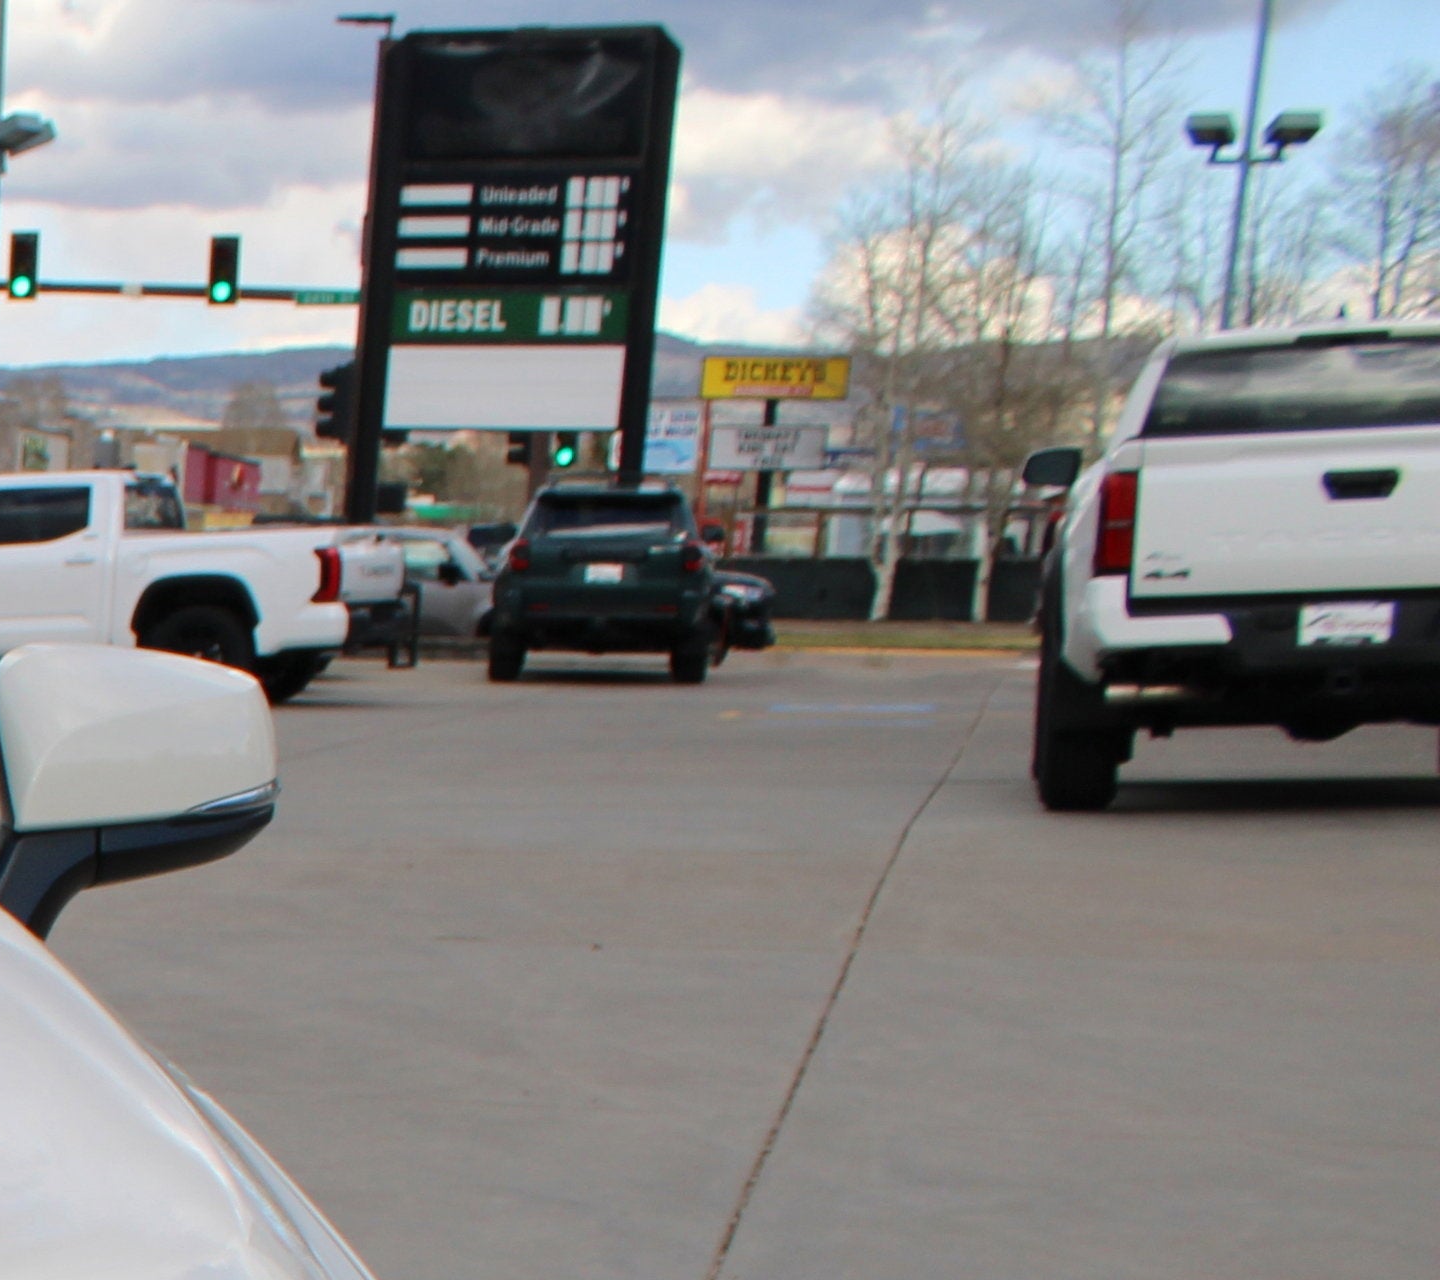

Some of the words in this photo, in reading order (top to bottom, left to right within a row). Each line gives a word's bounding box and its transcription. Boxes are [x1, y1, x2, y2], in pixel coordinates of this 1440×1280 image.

[480, 185, 558, 206] Unleaded
[475, 248, 550, 269] Premium
[408, 300, 508, 333] DIESEL
